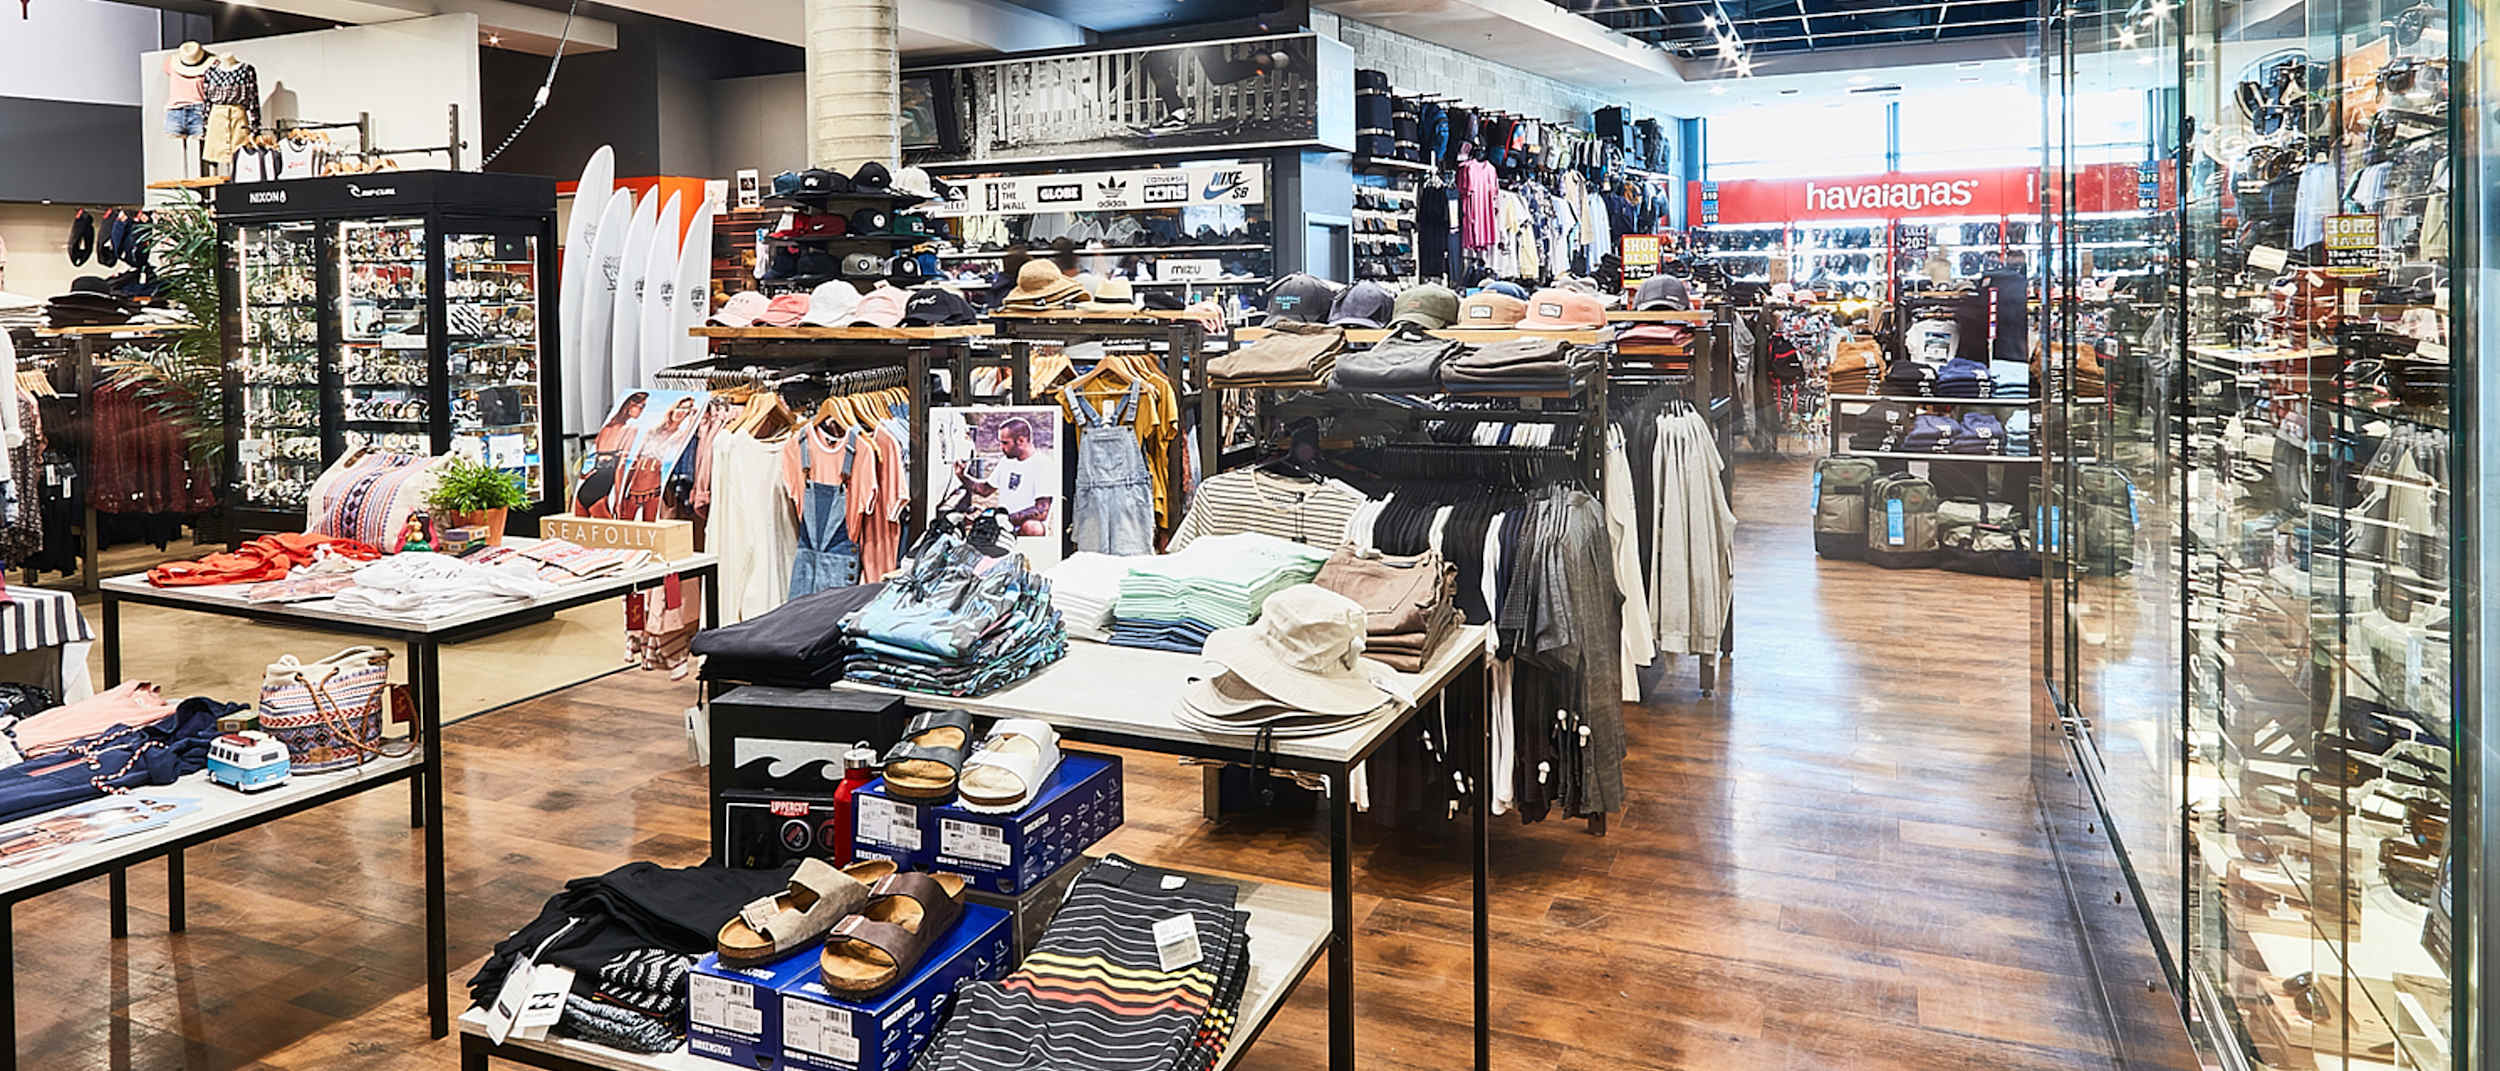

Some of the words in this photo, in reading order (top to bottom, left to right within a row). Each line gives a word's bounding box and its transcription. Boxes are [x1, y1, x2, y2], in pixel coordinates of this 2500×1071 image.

[1146, 175, 1185, 184] CONVERSE
[1211, 171, 1242, 187] NIKE
[1001, 182, 1017, 190] OFF
[249, 192, 280, 203] NIXON
[1001, 192, 1017, 200] THE
[1039, 186, 1079, 200] GLOBE
[1233, 187, 1249, 200] SB
[1806, 180, 1974, 210] havaianas
[1002, 202, 1026, 210] WALL
[1097, 199, 1127, 208] adidas
[1623, 239, 1658, 252] SHOE
[547, 521, 656, 547] SEAFOLLY
[771, 801, 809, 815] UPPERCUT
